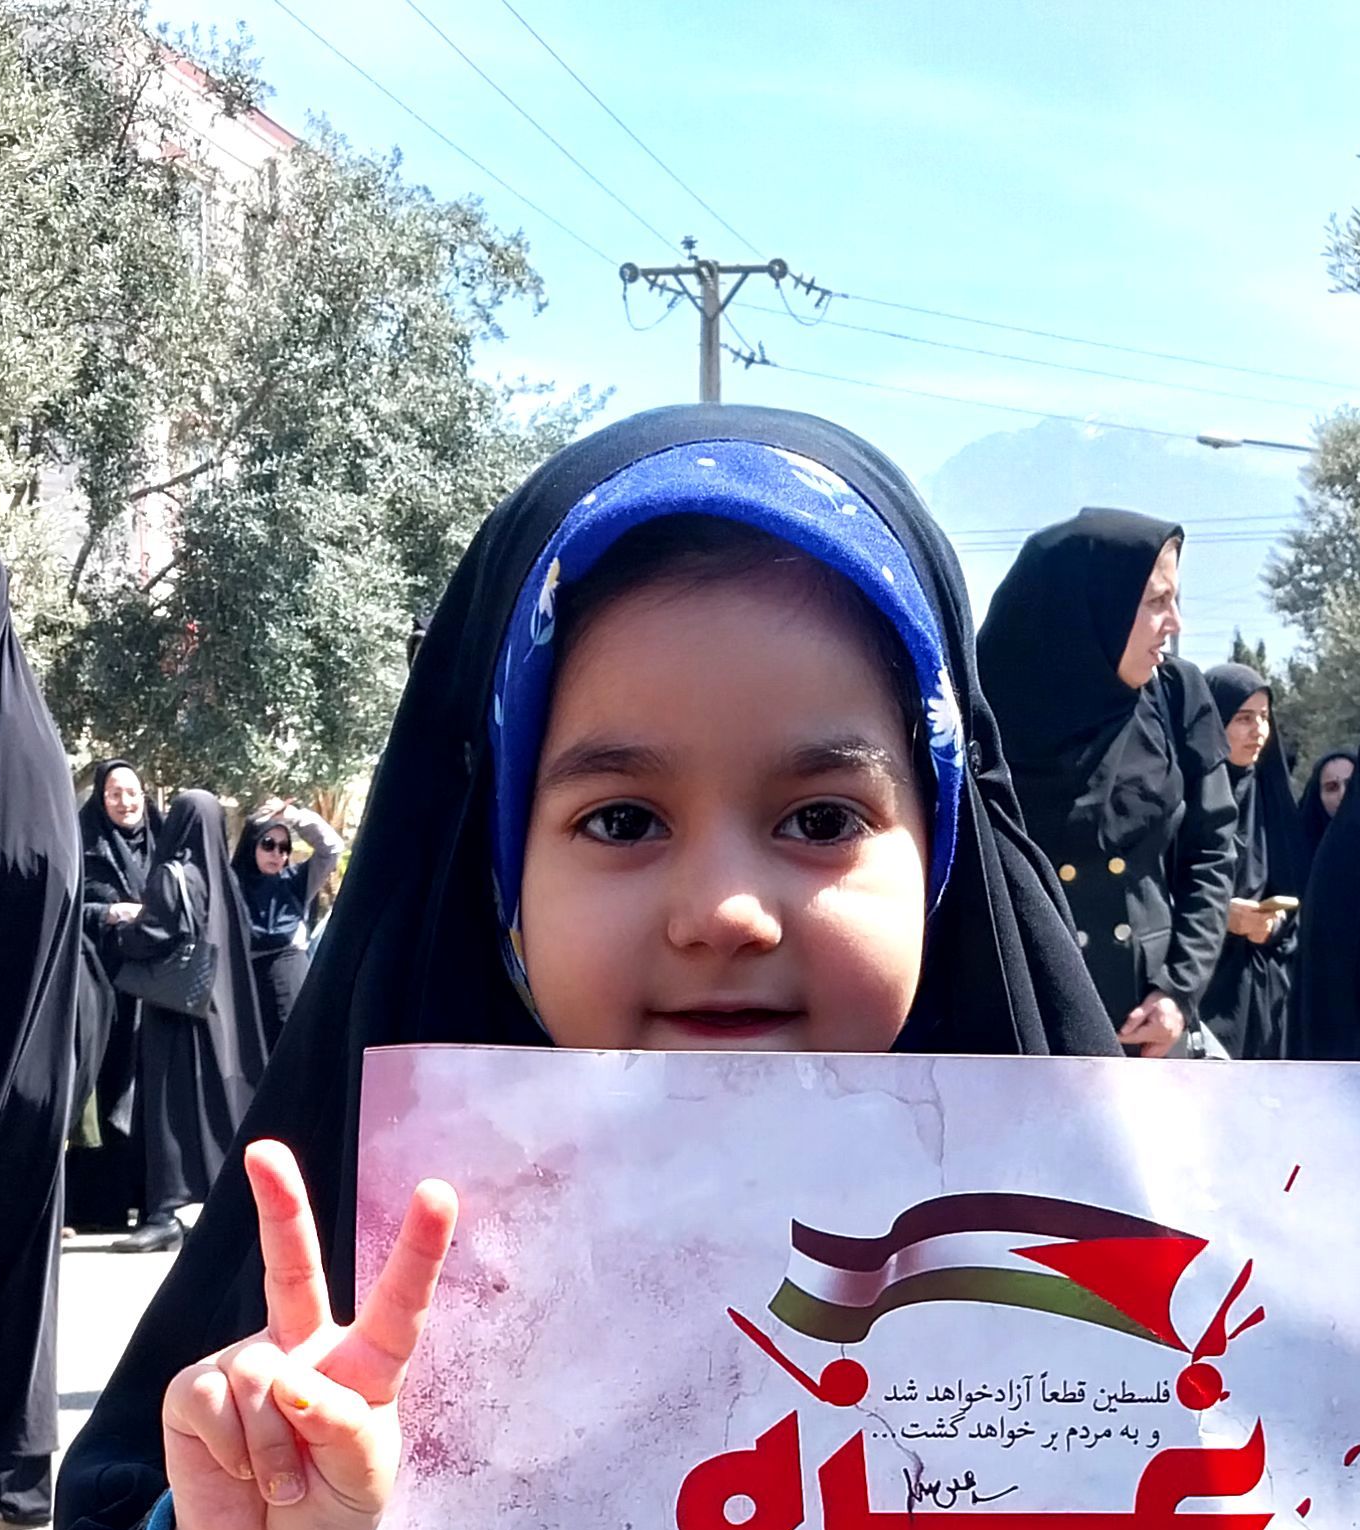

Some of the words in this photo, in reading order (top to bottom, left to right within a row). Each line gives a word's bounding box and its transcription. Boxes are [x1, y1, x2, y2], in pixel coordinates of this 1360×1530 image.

[884, 1379, 918, 1402] شد
[1093, 1380, 1171, 1413] فلسطین
[968, 1416, 1035, 1448] خواهد
[1041, 1432, 1059, 1451] بر
[1066, 1426, 1112, 1452] مردم
[1119, 1425, 1139, 1445] به
[1146, 1430, 1160, 1448] و
